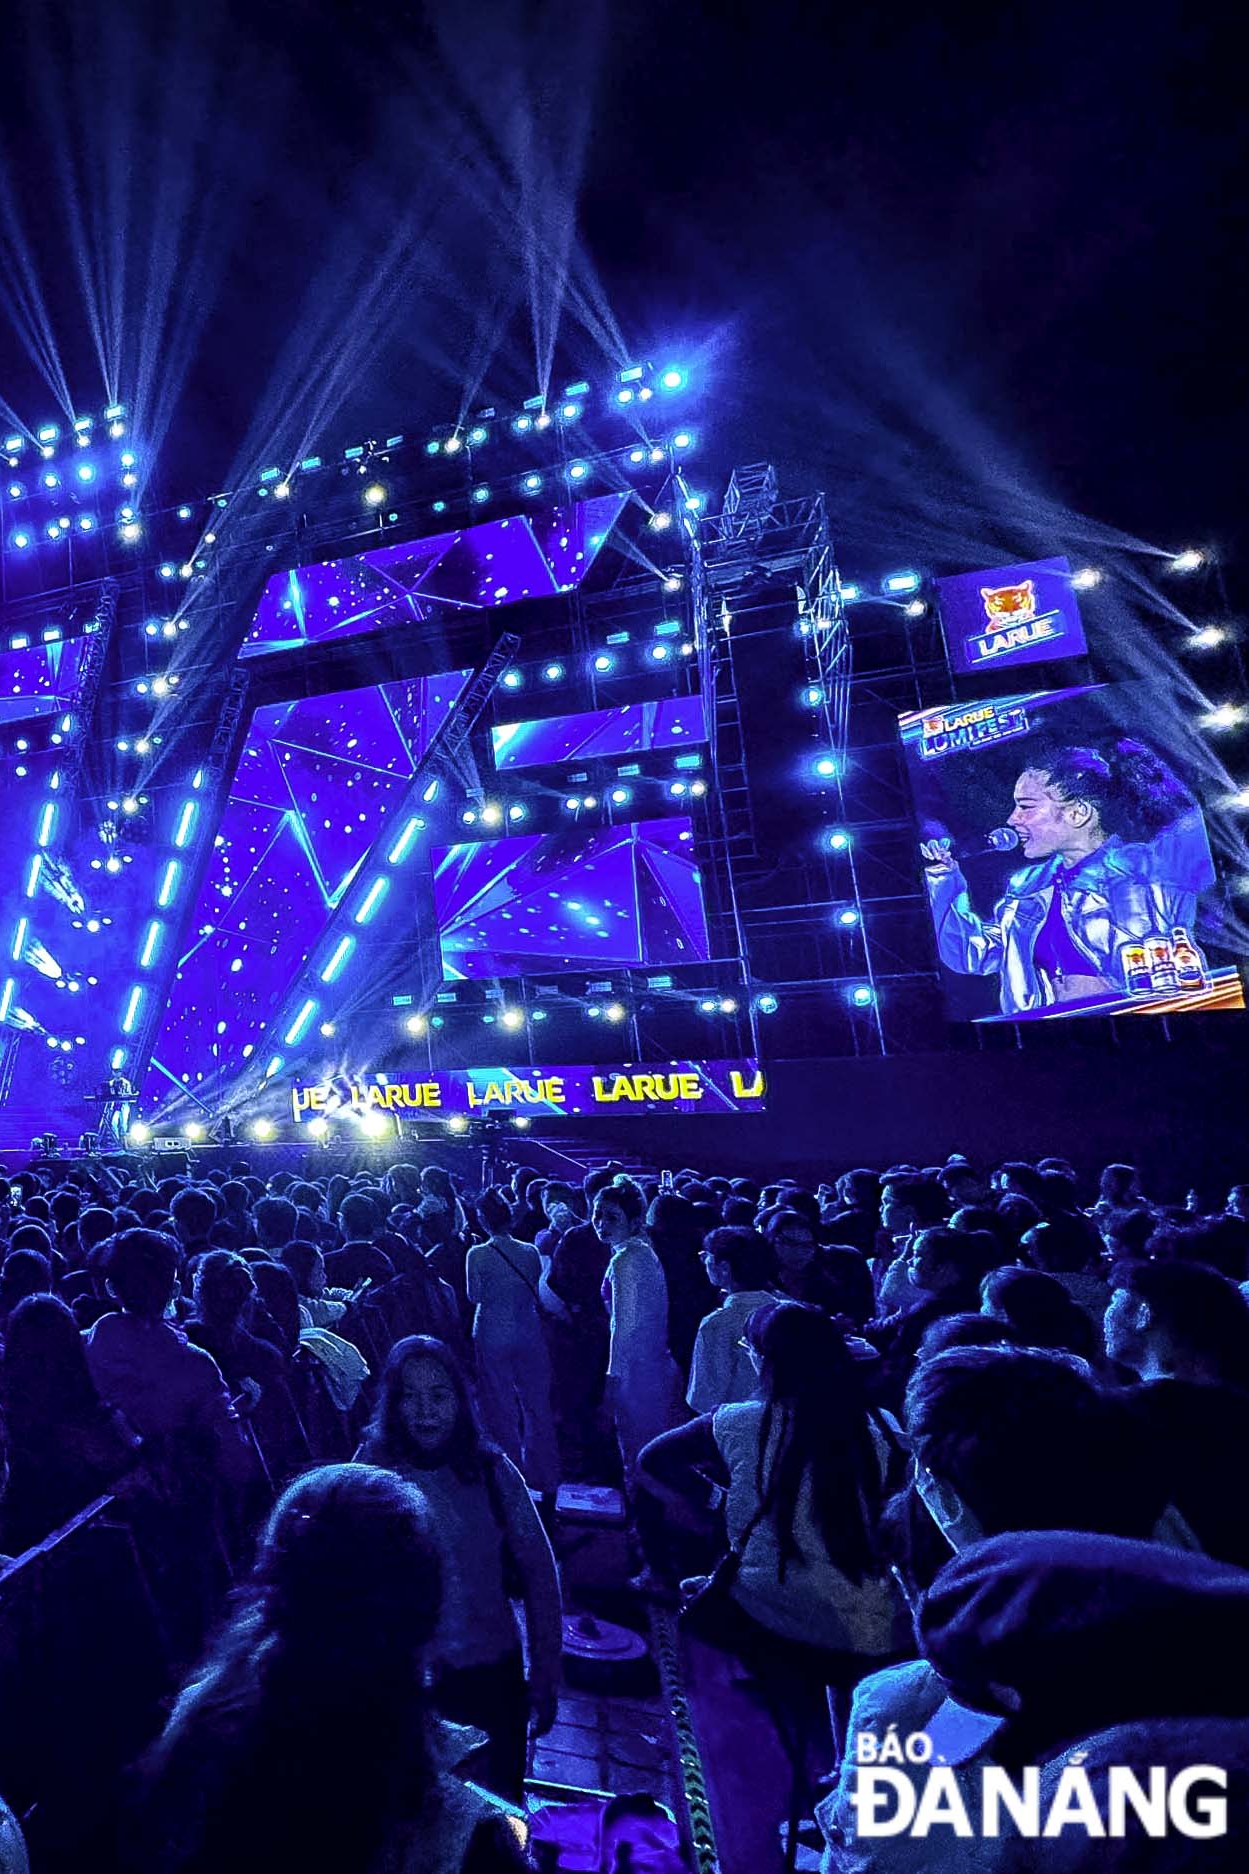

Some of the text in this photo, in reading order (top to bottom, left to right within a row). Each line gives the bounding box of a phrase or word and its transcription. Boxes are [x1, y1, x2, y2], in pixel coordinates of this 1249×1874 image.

[980, 619, 1055, 656] LARUE
[944, 706, 995, 732] LARUE
[351, 1082, 442, 1109] LARUE
[467, 1078, 566, 1108] LARUE
[593, 1073, 701, 1102] LARUE
